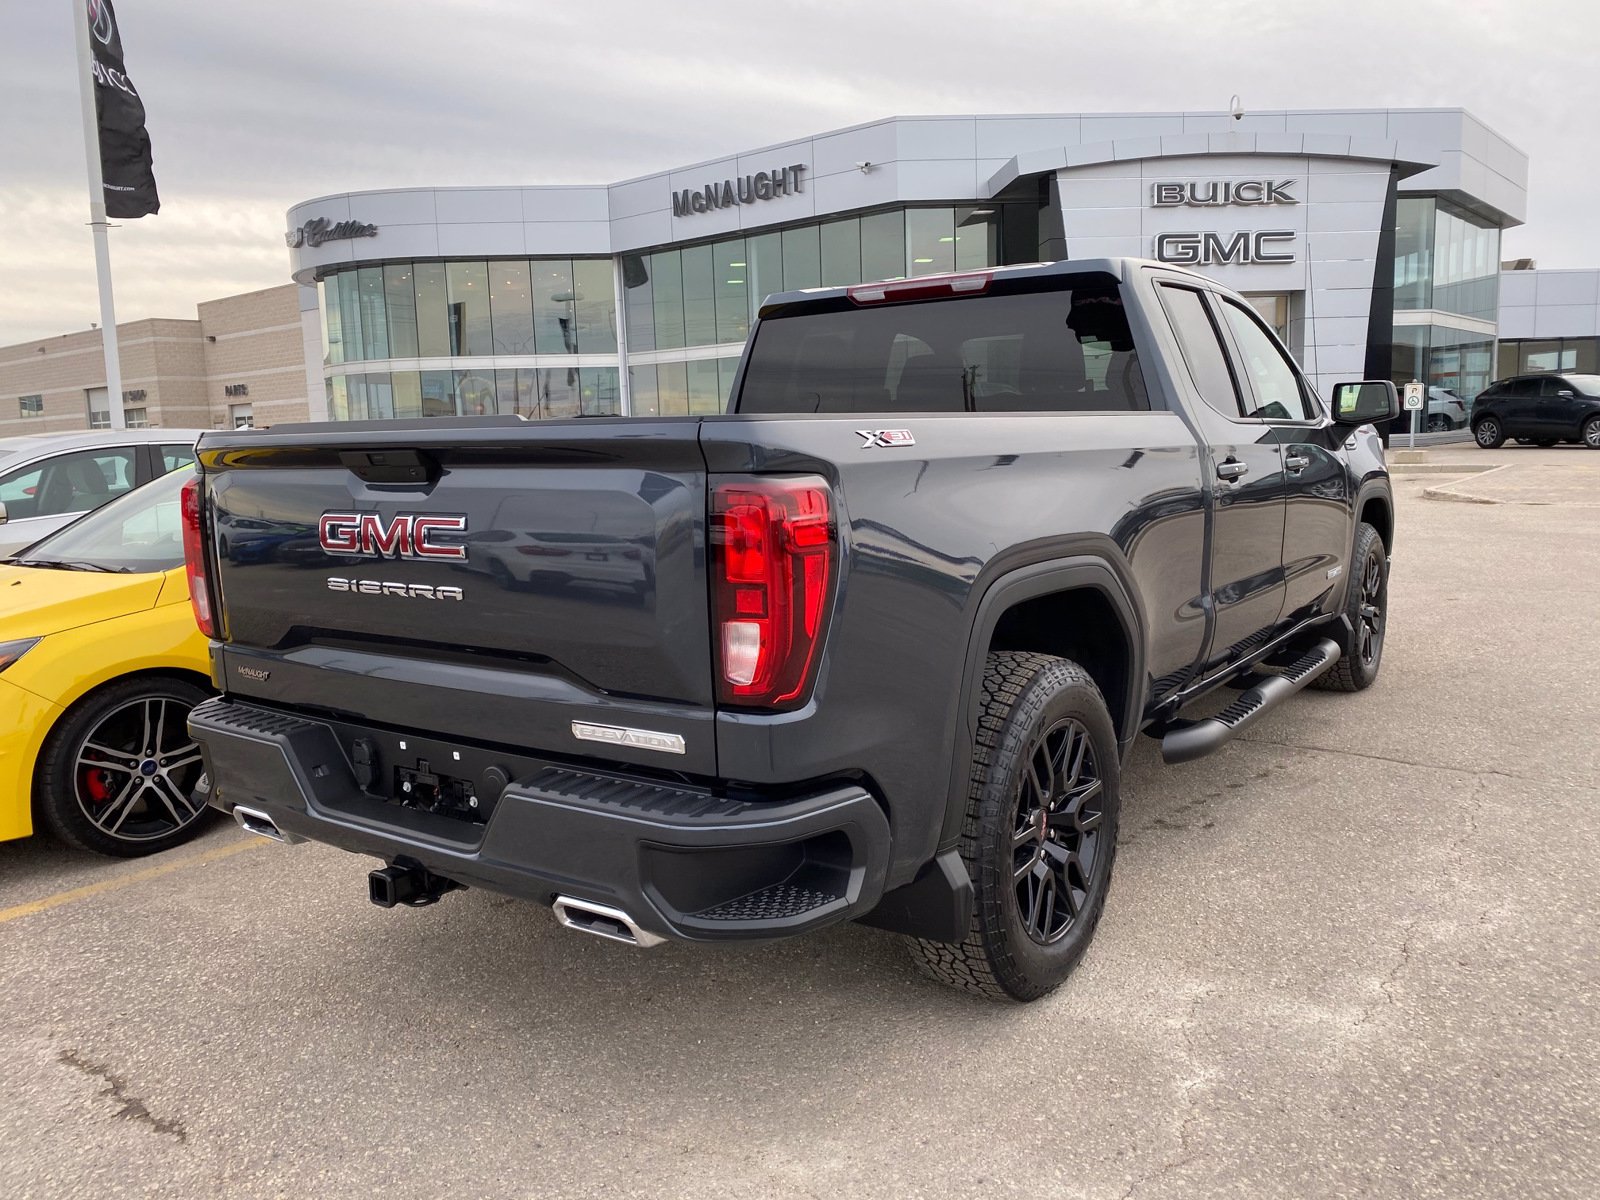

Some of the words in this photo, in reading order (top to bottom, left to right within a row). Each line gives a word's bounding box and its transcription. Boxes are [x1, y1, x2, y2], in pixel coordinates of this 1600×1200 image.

[1153, 179, 1299, 207] BUICK
[304, 217, 377, 247] Cadillac
[1154, 231, 1296, 264] GMC
[319, 512, 468, 562] GMC
[327, 577, 464, 601] SIERRA
[576, 725, 681, 751] ELEVATION
